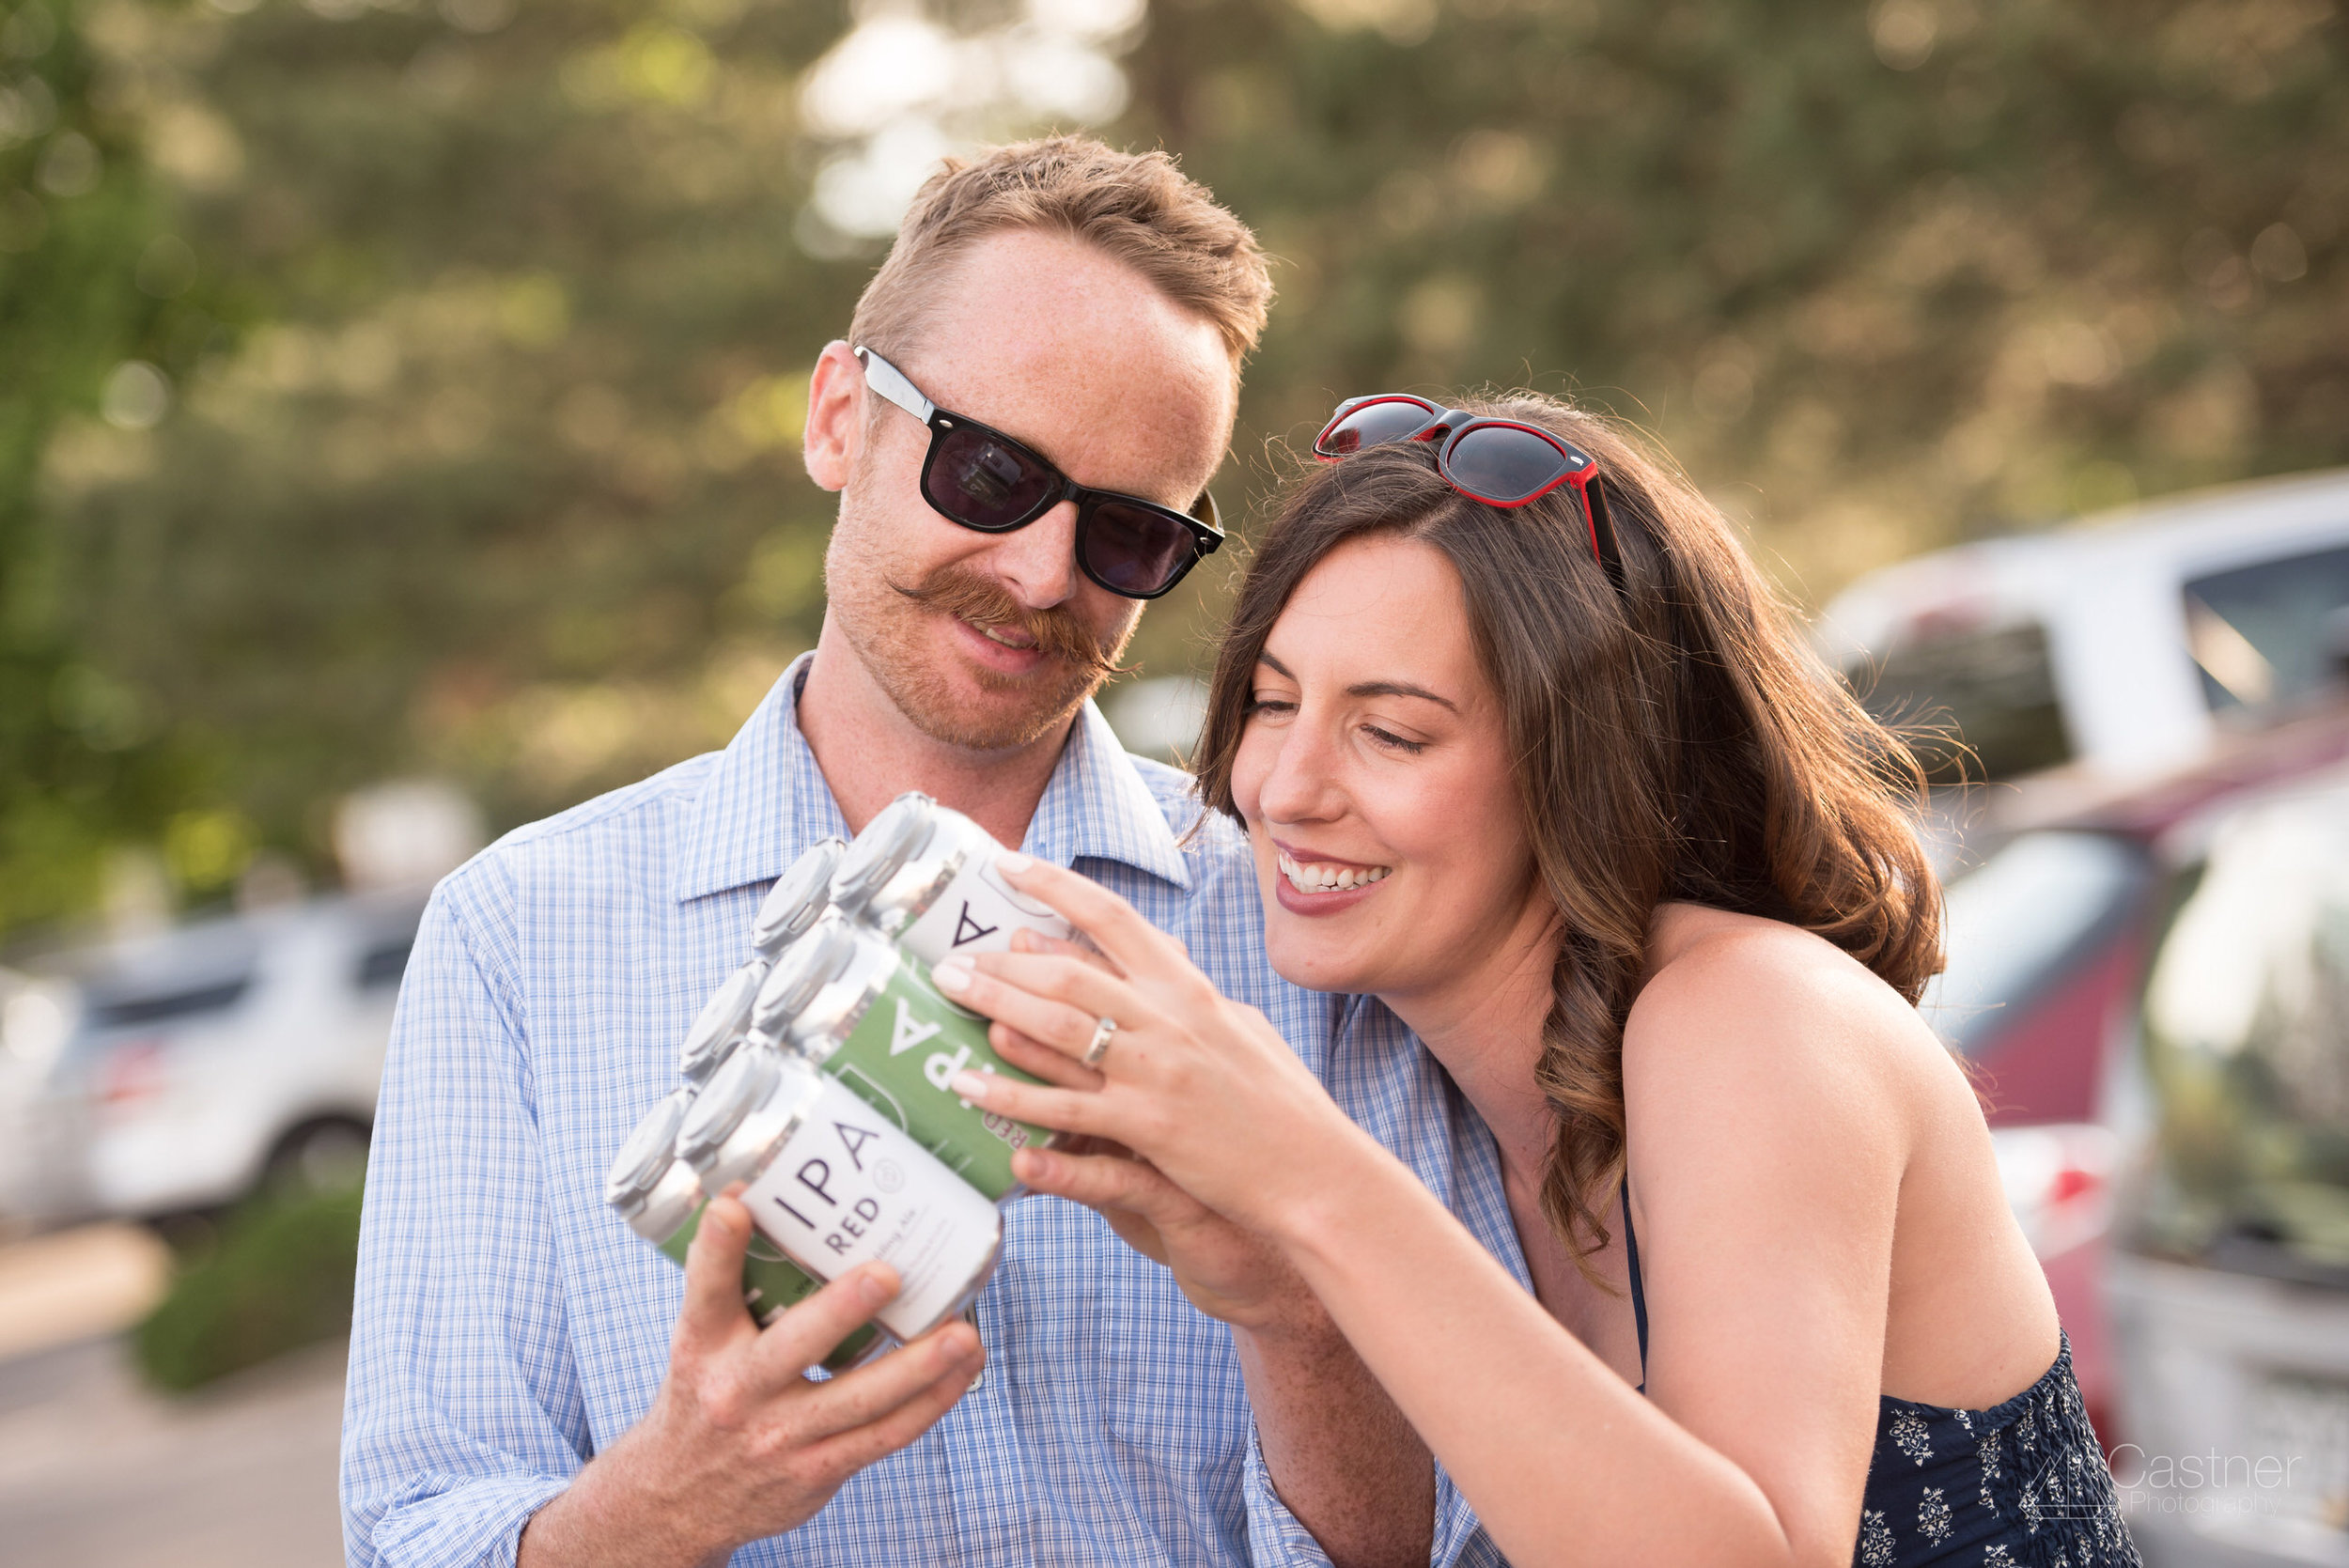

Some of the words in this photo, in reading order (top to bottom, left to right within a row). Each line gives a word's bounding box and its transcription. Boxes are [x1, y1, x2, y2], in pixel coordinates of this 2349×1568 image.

[890, 996, 996, 1110] PA
[982, 1111, 1030, 1151] RED
[773, 1122, 880, 1230] IPA
[824, 1197, 879, 1256] RED
